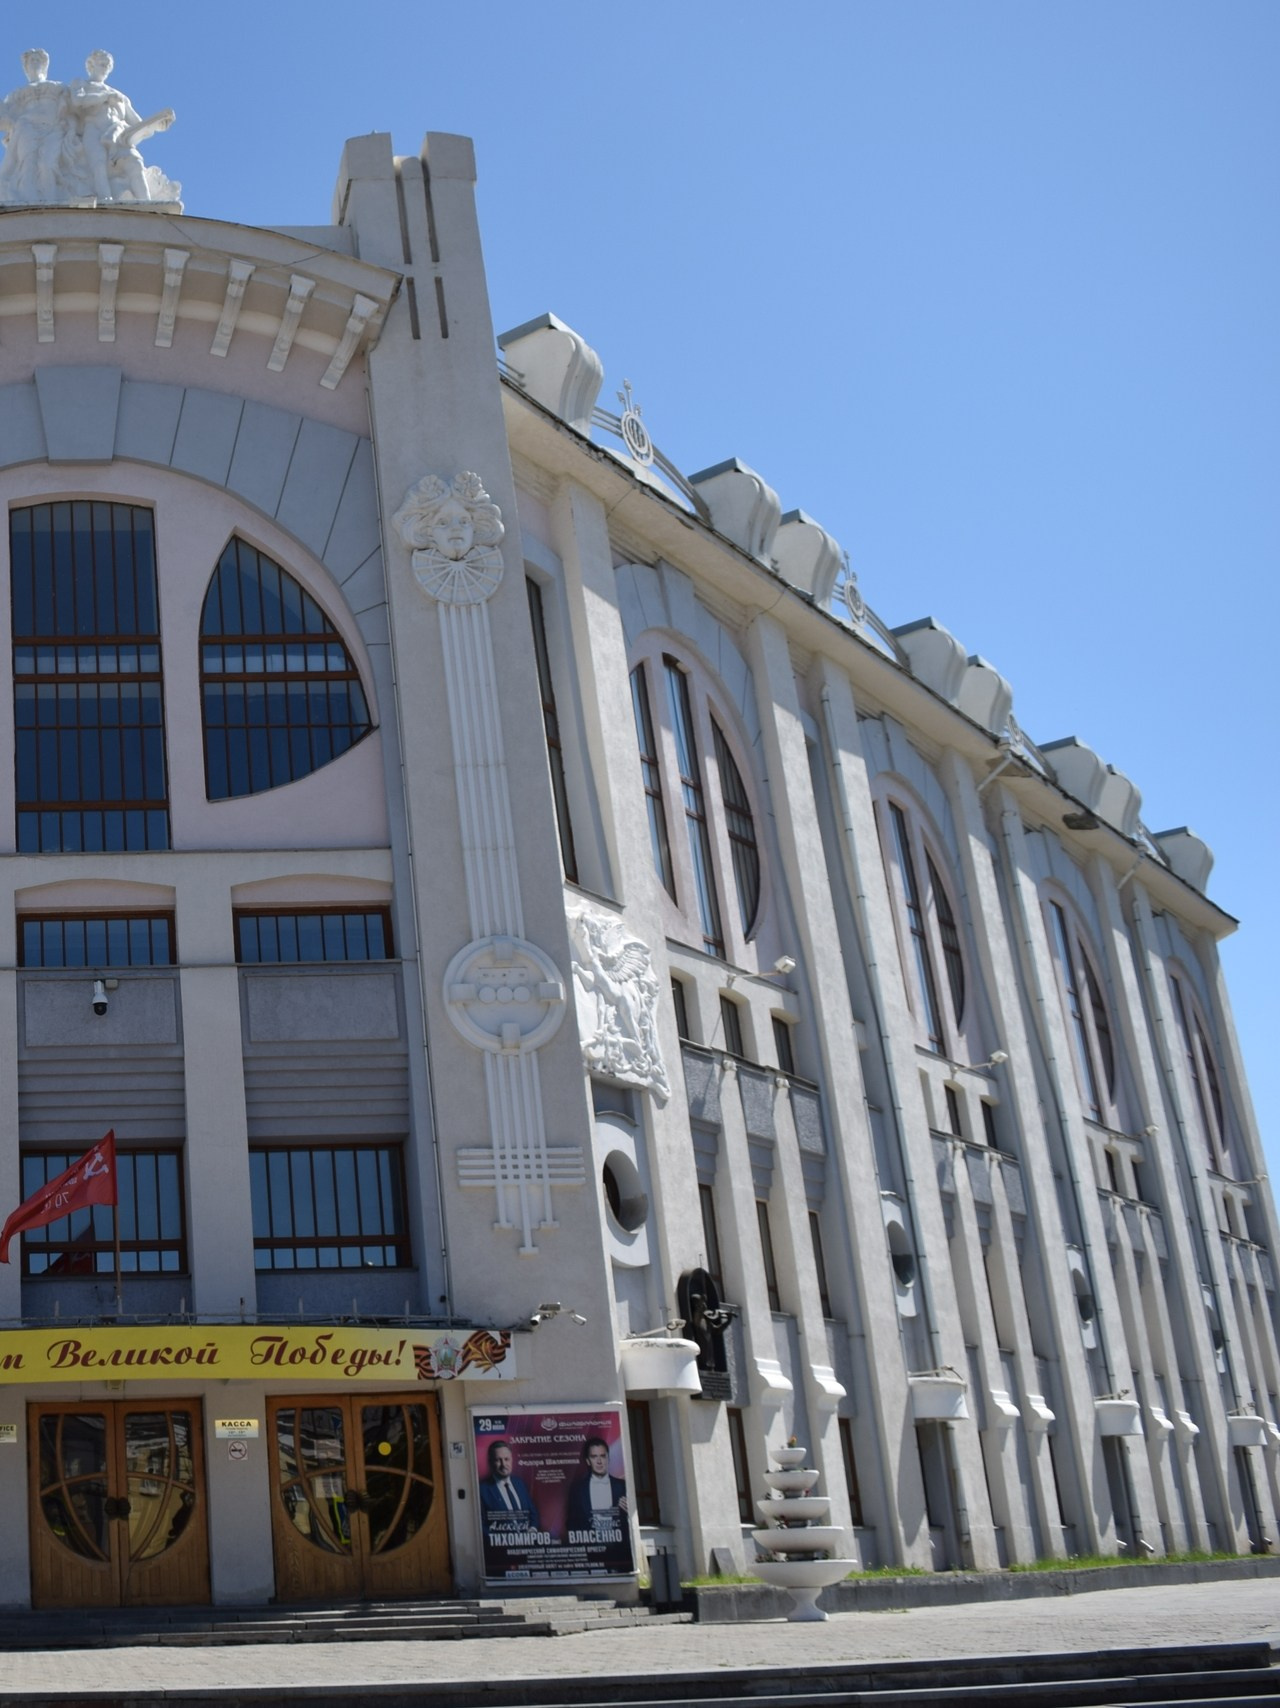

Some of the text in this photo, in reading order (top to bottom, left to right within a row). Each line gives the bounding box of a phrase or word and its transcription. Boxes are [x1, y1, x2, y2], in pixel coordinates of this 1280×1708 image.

[46, 1339, 222, 1370] Великой
[250, 1333, 407, 1378] Победы!
[478, 1418, 492, 1432] 29
[509, 1434, 587, 1444] ЗАКРЫТИЕ СЕЗОНА
[488, 1531, 551, 1546] ТИХОМИРОВ
[568, 1528, 623, 1544] ВЛАСЕНКО
